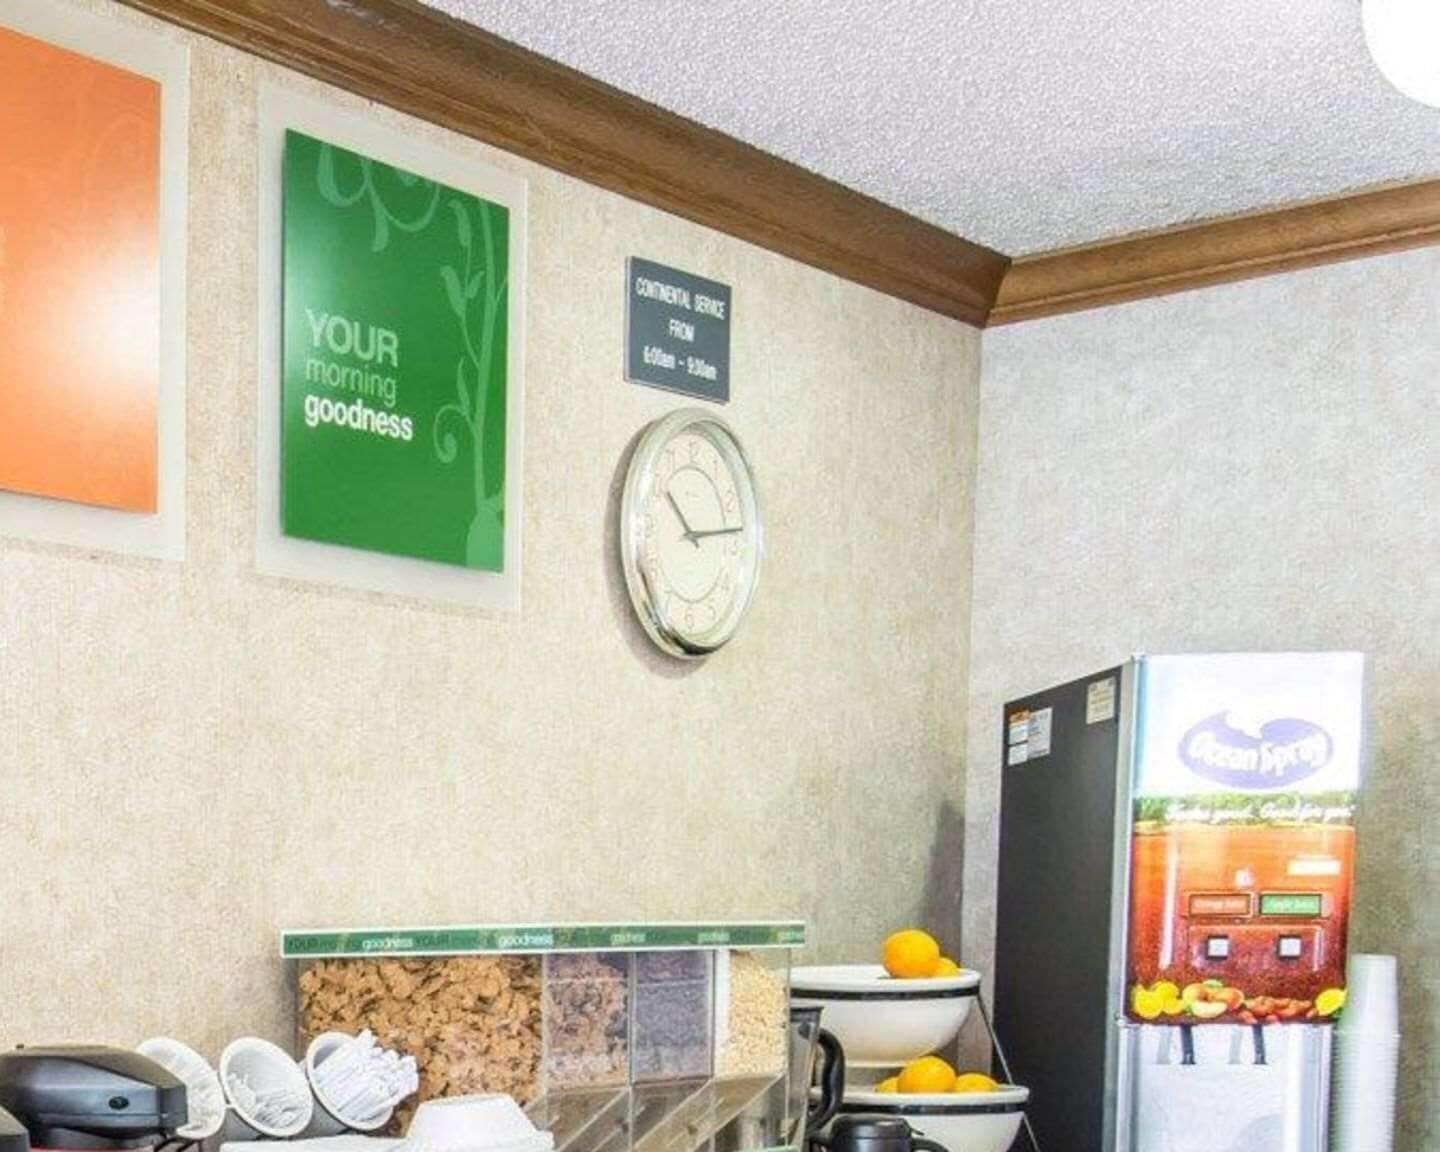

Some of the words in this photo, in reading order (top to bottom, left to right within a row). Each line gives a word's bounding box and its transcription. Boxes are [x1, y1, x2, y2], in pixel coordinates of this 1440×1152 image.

[305, 307, 398, 367] YOUR
[668, 318, 695, 342] FROM
[306, 357, 396, 407] morning
[304, 393, 413, 441] goodness
